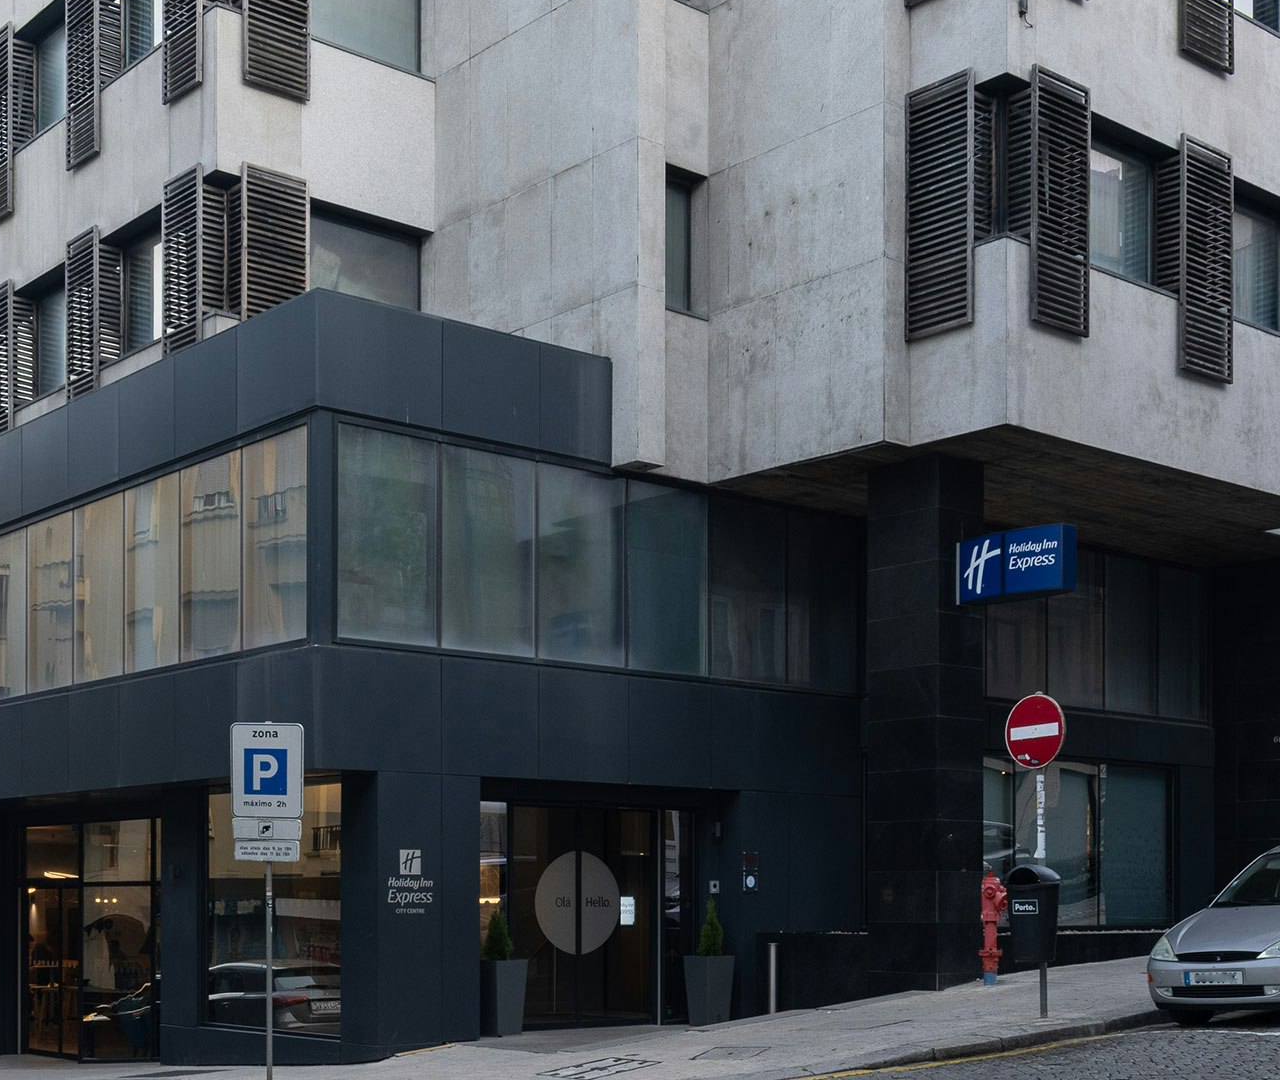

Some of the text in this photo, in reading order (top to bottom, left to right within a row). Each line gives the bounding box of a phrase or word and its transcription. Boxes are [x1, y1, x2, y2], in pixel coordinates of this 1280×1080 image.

[1008, 538, 1058, 554] Holiday Inn
[1008, 553, 1056, 571] Express
[253, 754, 278, 790] P
[388, 877, 434, 890] Holiday Inn
[388, 889, 433, 906] Express
[555, 896, 571, 908] Olá
[586, 896, 612, 908] Hello.
[1015, 903, 1035, 911] Porto.
